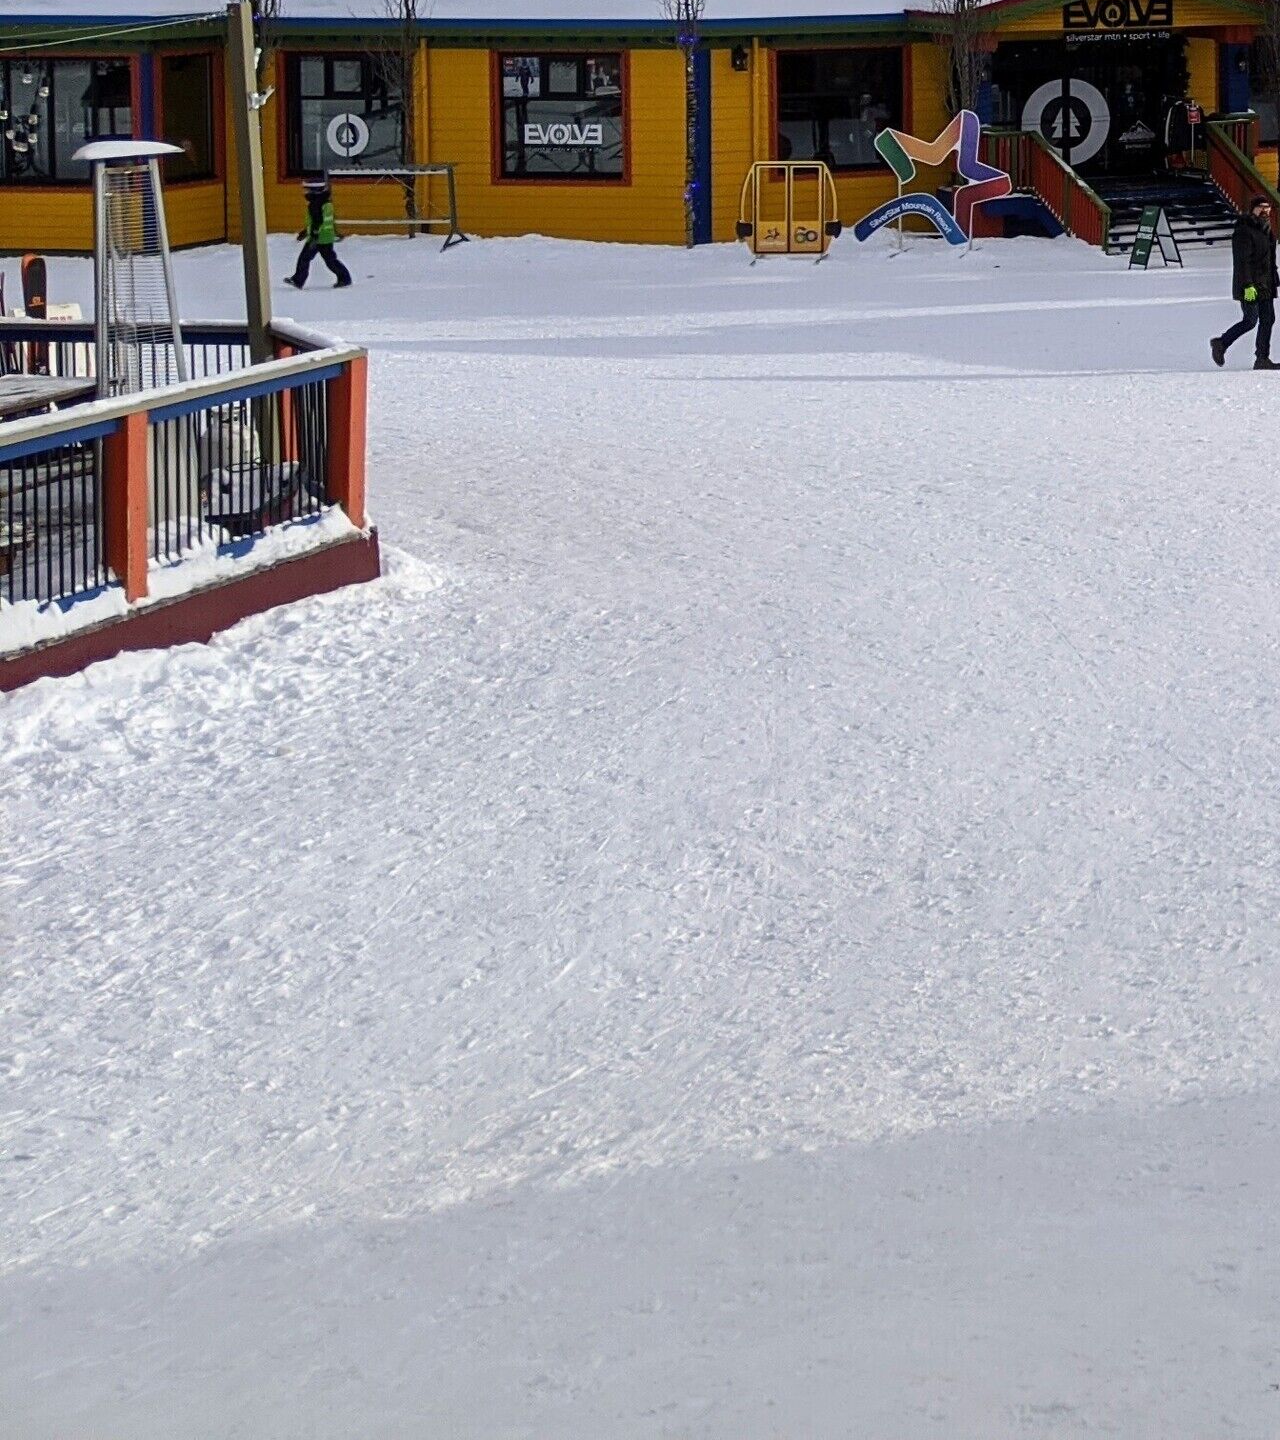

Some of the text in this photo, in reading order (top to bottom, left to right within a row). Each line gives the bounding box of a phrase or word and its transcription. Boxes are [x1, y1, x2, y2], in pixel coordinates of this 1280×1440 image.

[1066, 30, 1170, 43] silverstar mtn sport life
[524, 123, 603, 145] EVOLVE
[901, 202, 936, 215] Mountain
[933, 211, 953, 235] Resort
